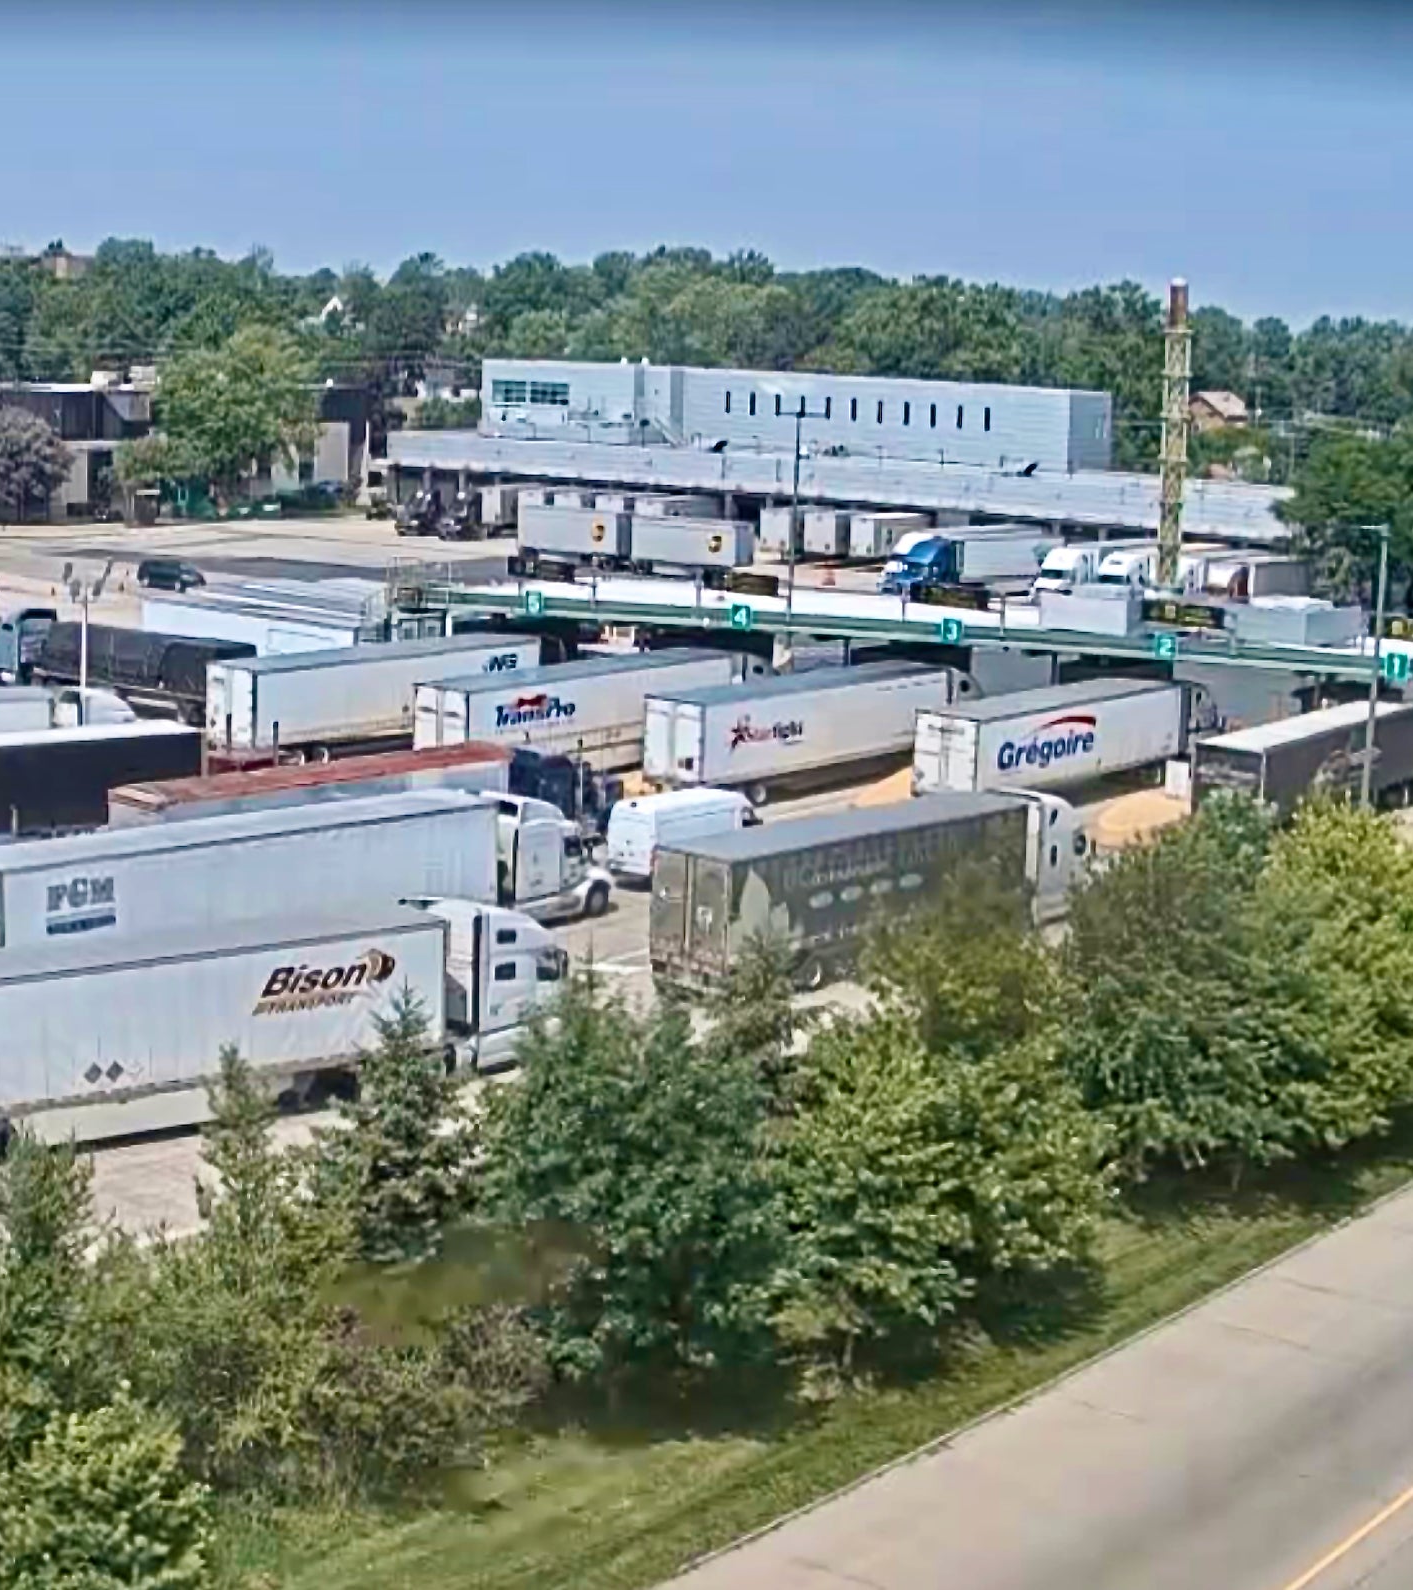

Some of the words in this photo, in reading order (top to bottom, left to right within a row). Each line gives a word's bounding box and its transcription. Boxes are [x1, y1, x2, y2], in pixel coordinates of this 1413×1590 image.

[734, 607, 747, 626] 4
[947, 623, 957, 641] 3
[1159, 638, 1171, 655] 2
[998, 730, 1094, 770] Grégoire
[261, 964, 367, 998] Bison
